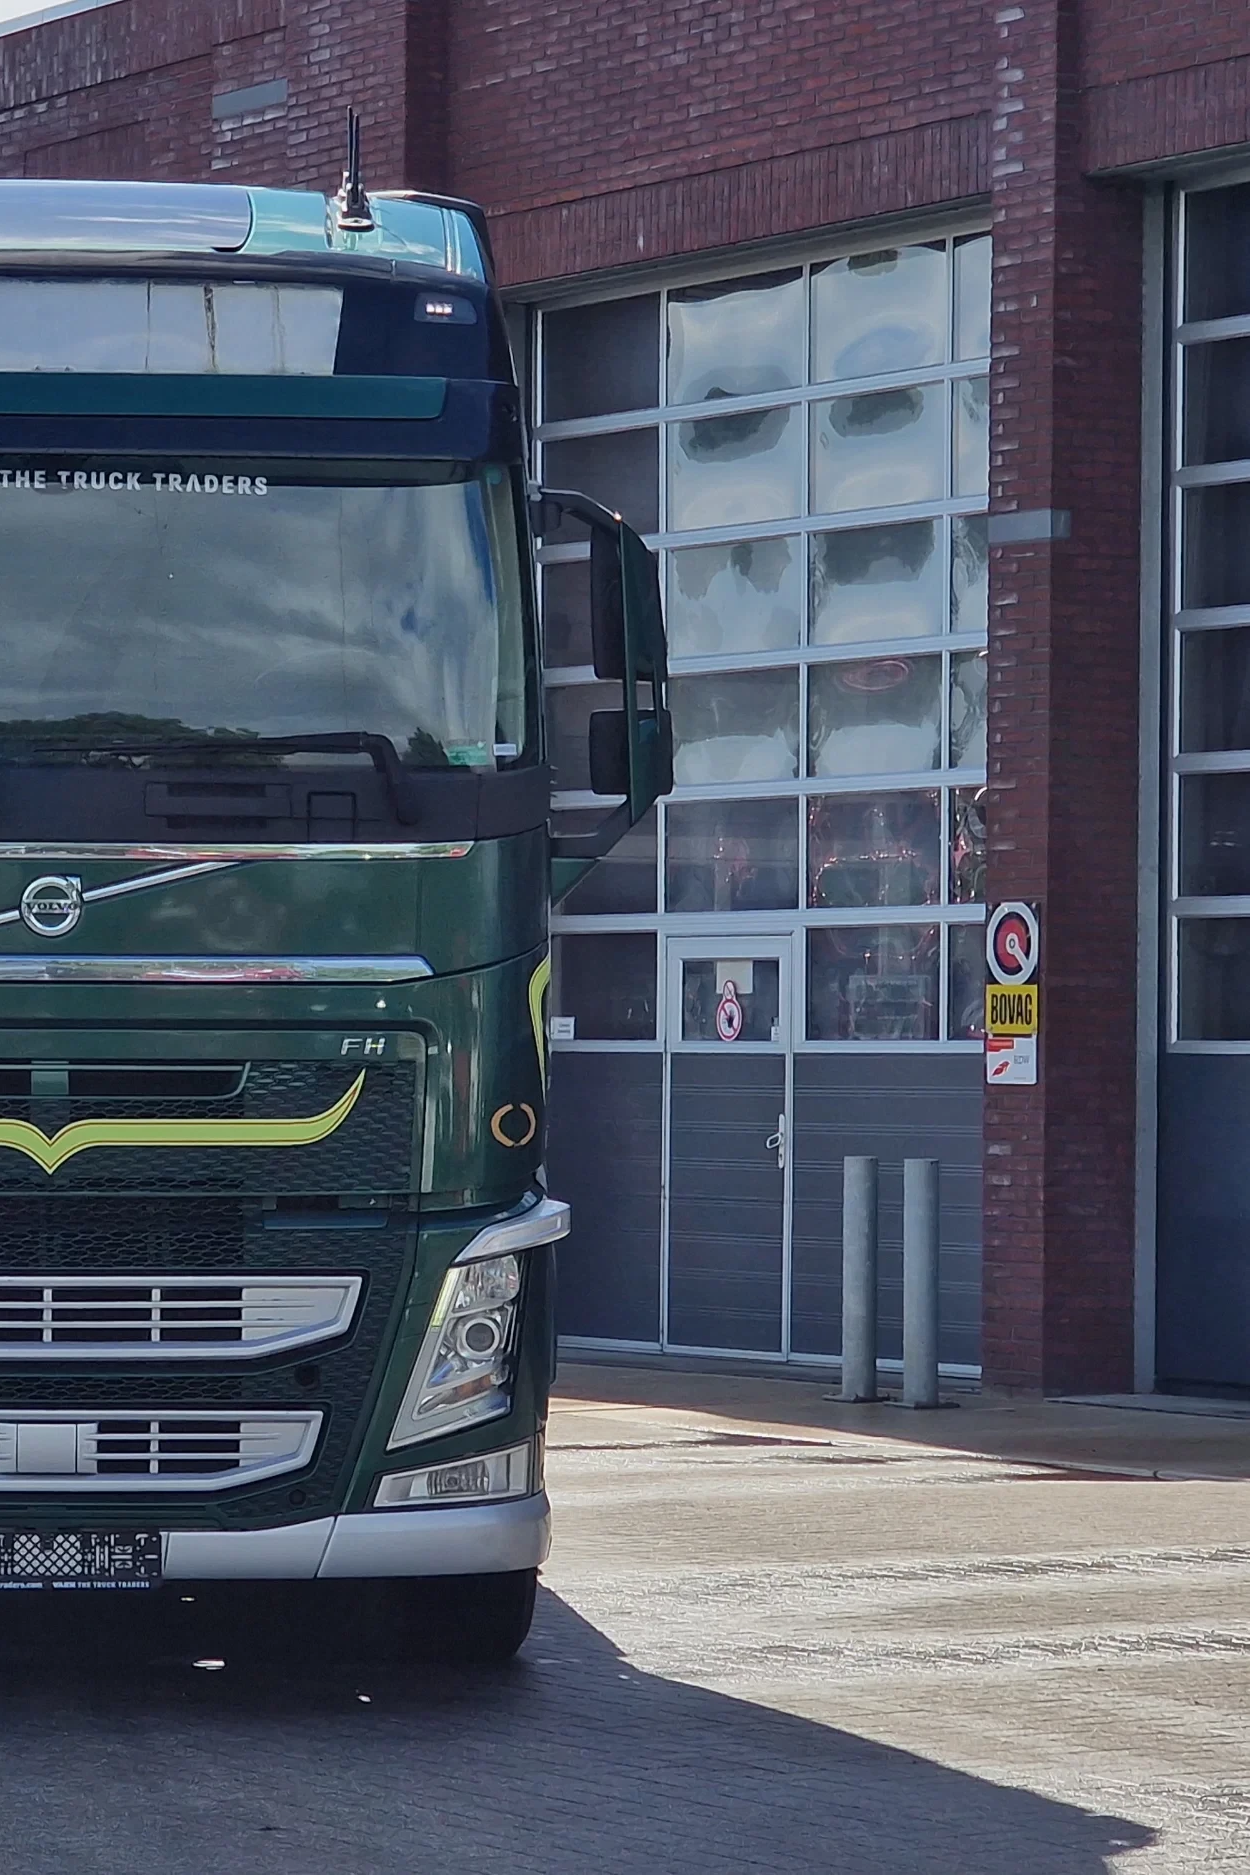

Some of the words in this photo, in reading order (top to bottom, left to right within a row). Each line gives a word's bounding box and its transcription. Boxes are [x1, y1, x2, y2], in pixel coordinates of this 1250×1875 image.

[0, 469, 47, 489] THE
[57, 470, 142, 491] TRUCK
[153, 472, 268, 496] TRADERS
[24, 902, 80, 913] VOLVO
[990, 993, 1033, 1026] BOVAG
[340, 1037, 386, 1056] FH
